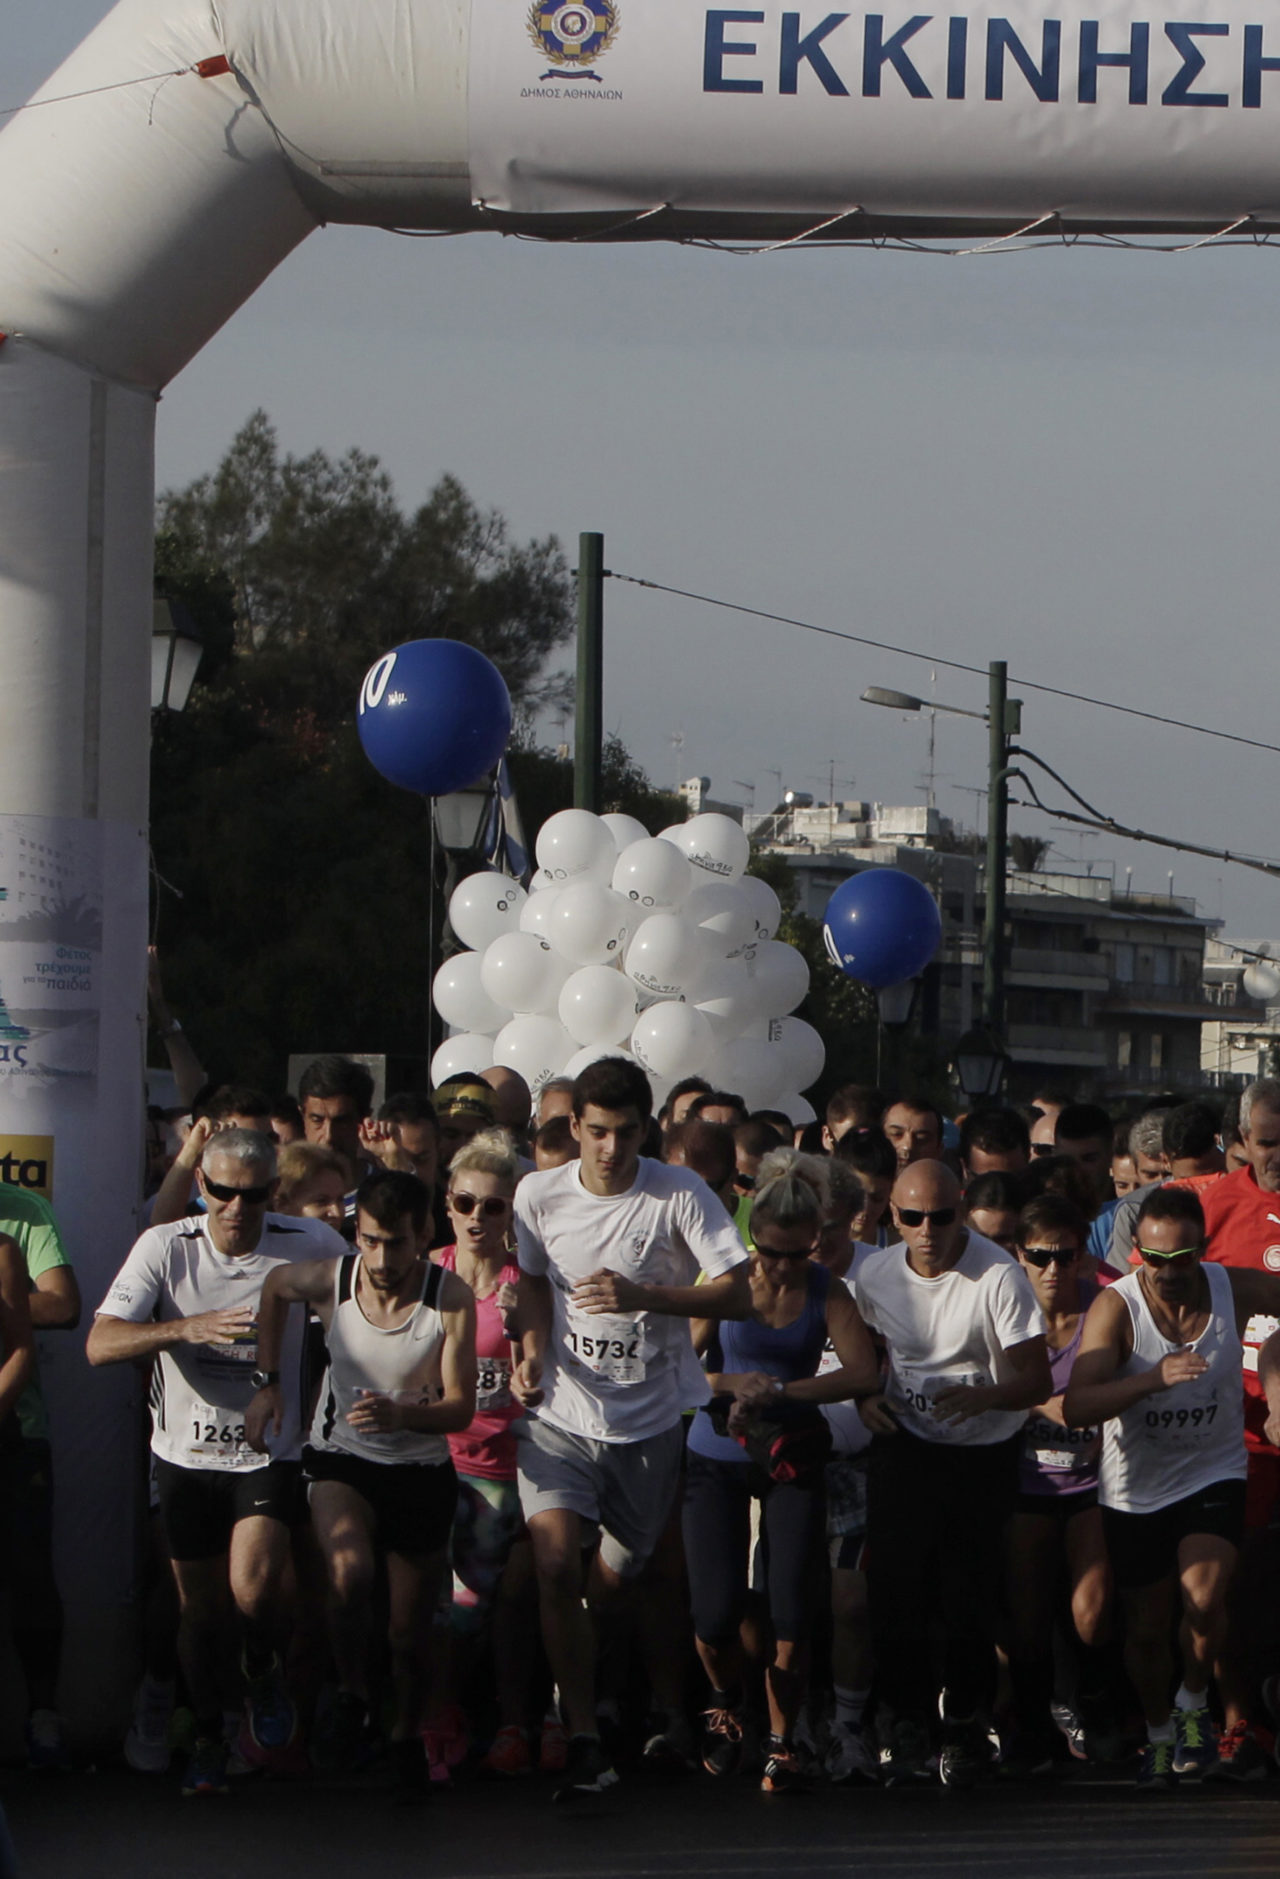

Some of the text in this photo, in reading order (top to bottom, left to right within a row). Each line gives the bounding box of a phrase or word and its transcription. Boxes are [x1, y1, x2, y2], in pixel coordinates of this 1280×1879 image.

[520, 87, 623, 100] ΔΗΜΟΣ ΑΘΗΝΑΙΩΝ
[1145, 1404, 1218, 1428] 09997
[193, 1420, 246, 1443] 1263
